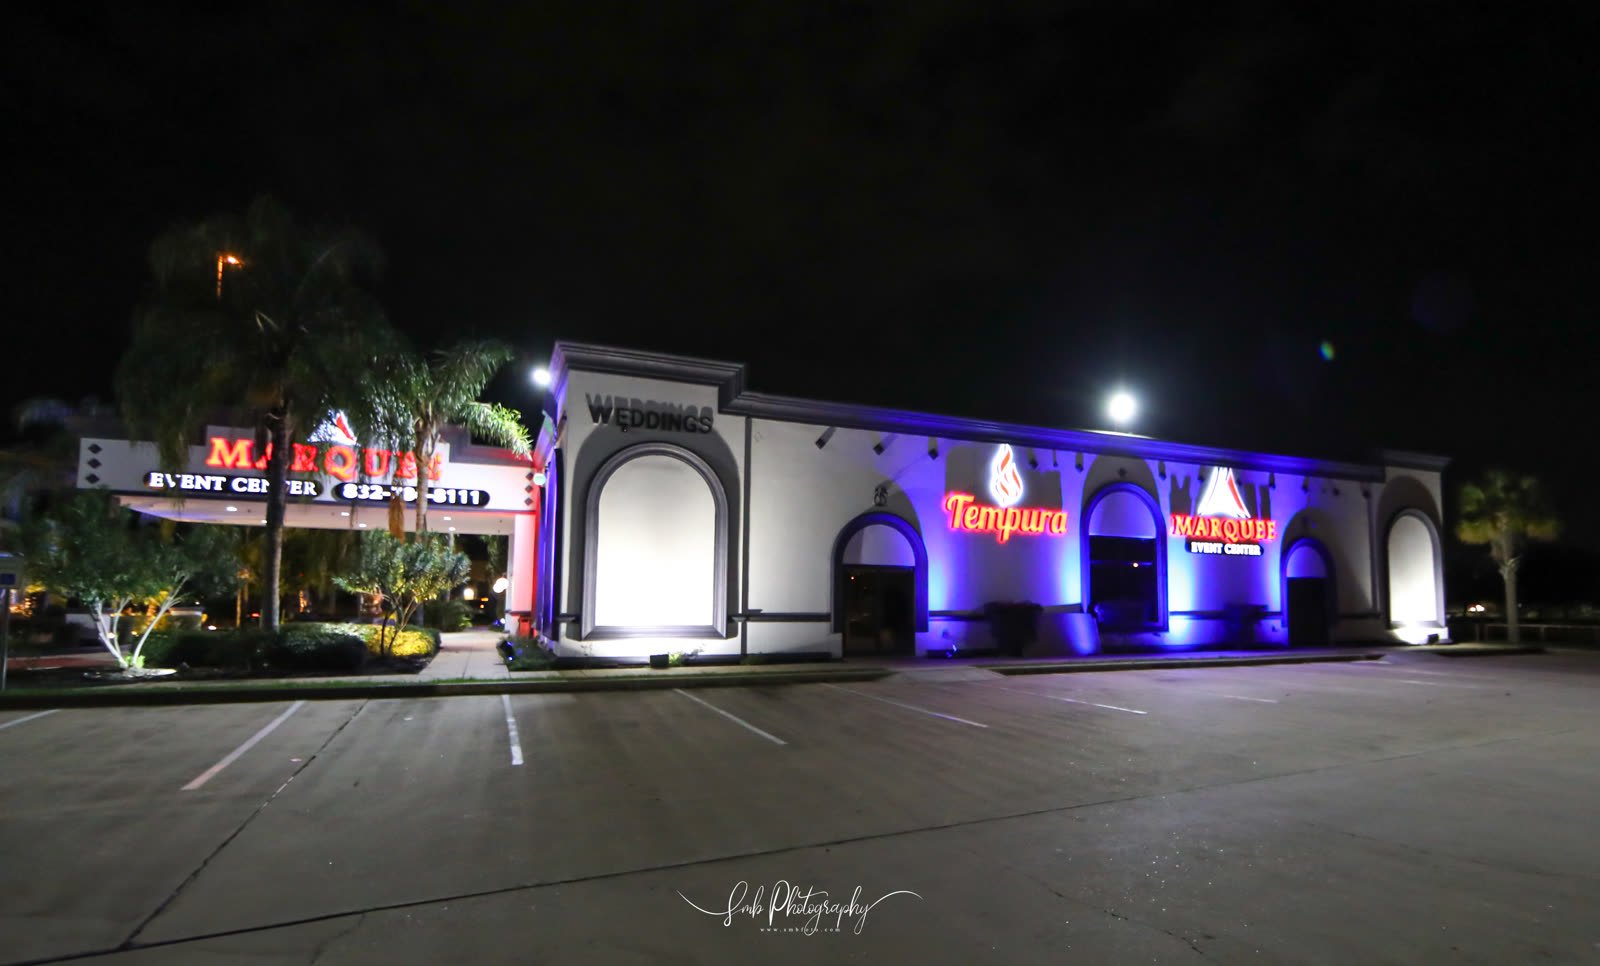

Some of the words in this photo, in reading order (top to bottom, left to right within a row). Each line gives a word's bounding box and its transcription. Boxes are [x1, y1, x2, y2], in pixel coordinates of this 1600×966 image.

[588, 403, 714, 434] WEDDINGS
[149, 472, 227, 491] EVENT
[945, 494, 1068, 542] Tempura
[1172, 515, 1277, 542] MARQUEE
[1191, 541, 1223, 554] EVENT
[1224, 543, 1261, 556] CENTER
